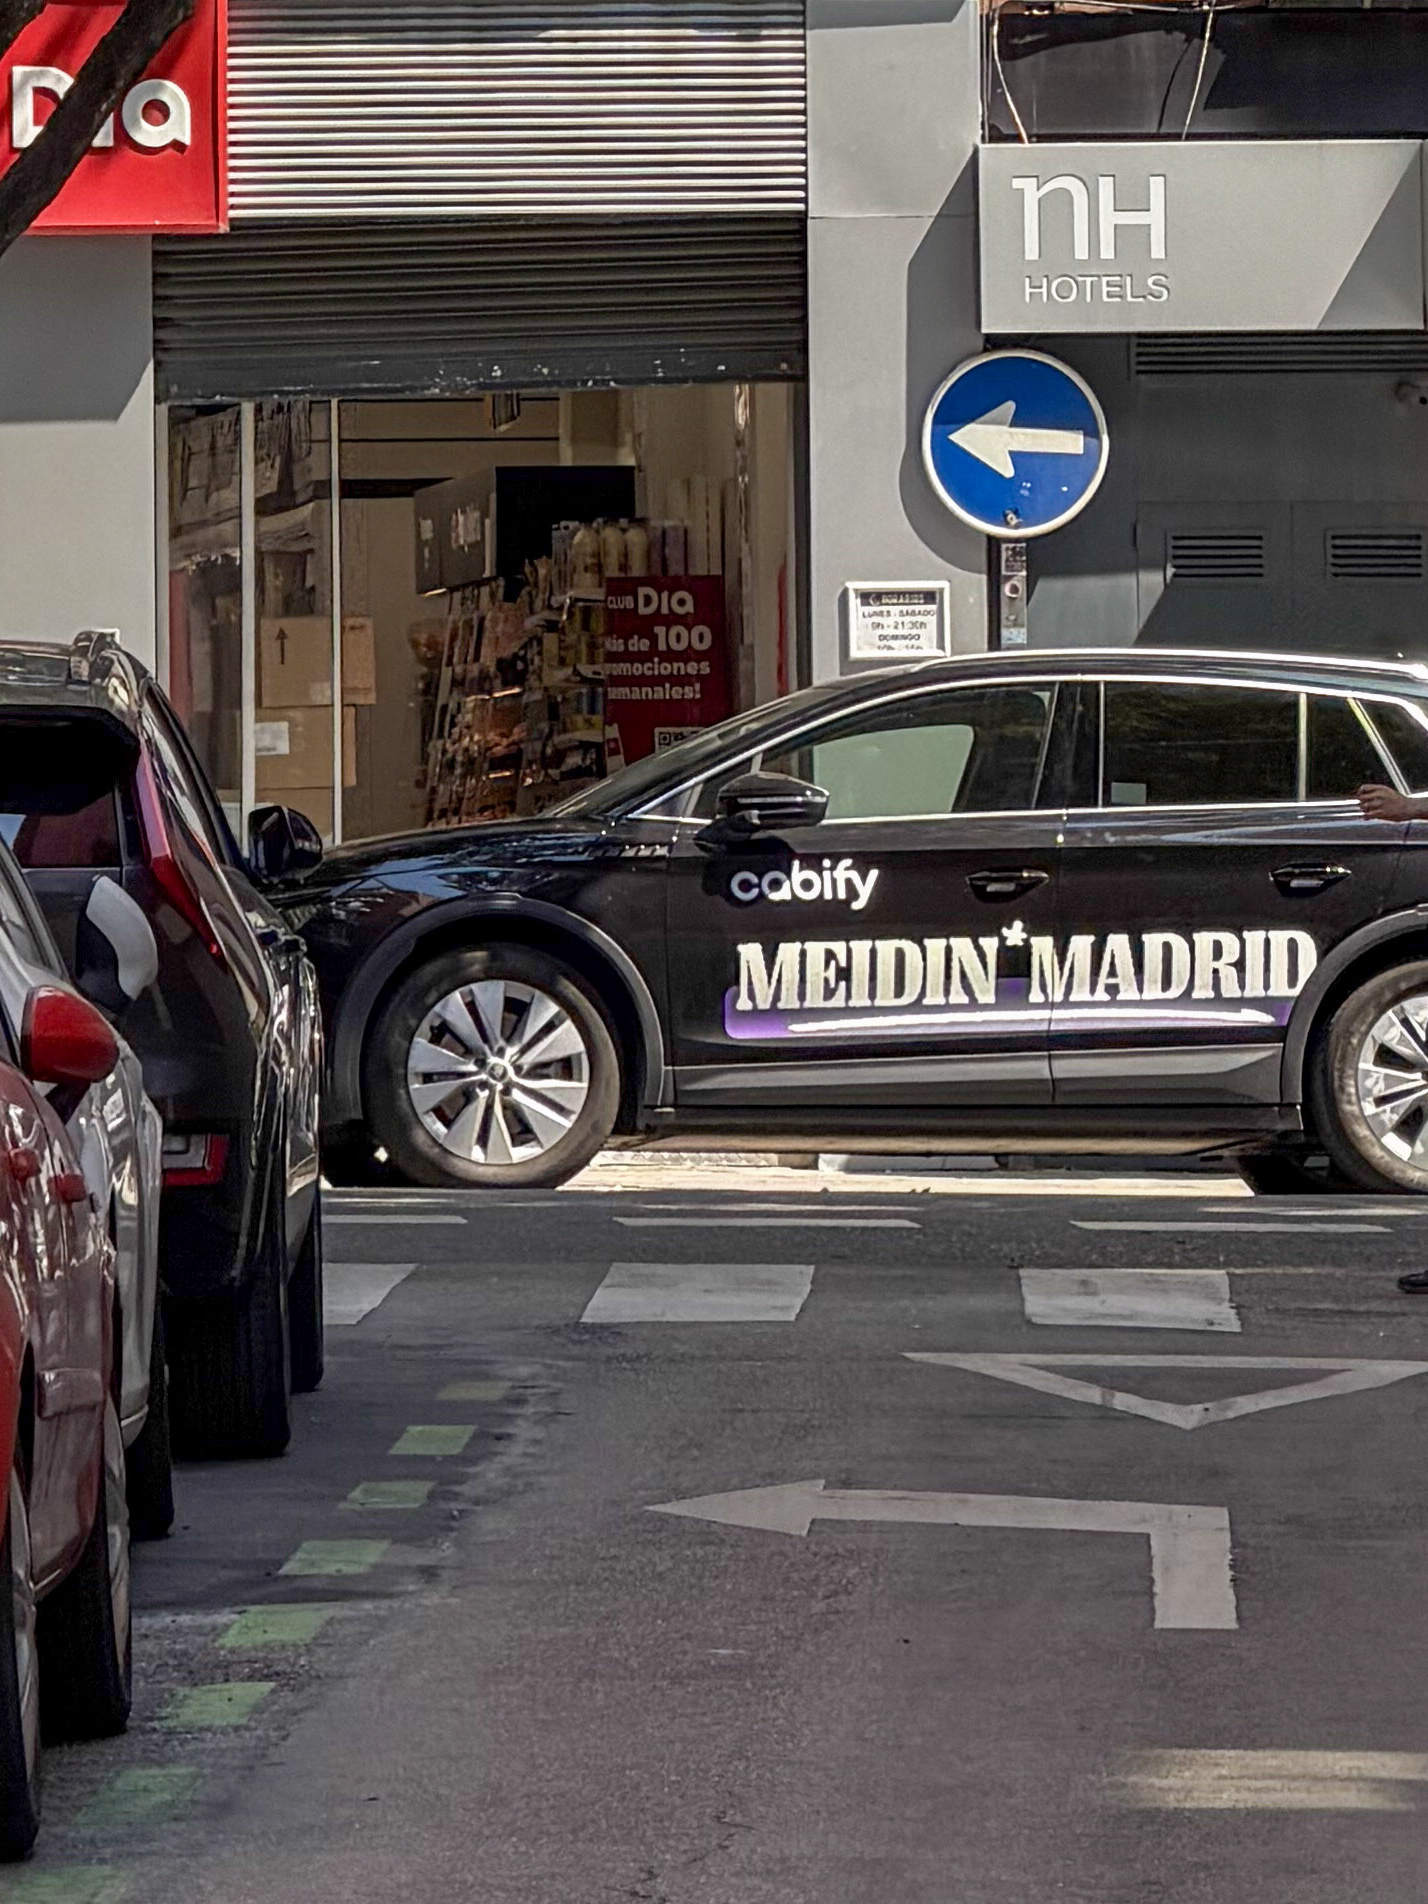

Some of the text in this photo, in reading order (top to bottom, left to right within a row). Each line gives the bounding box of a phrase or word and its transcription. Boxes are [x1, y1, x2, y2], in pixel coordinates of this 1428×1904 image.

[11, 65, 192, 148] Da
[1024, 273, 1170, 304] HOTELS
[627, 634, 650, 652] de
[653, 624, 713, 652] 100
[730, 858, 879, 911] cabify
[1028, 930, 1318, 1004] MADRID
